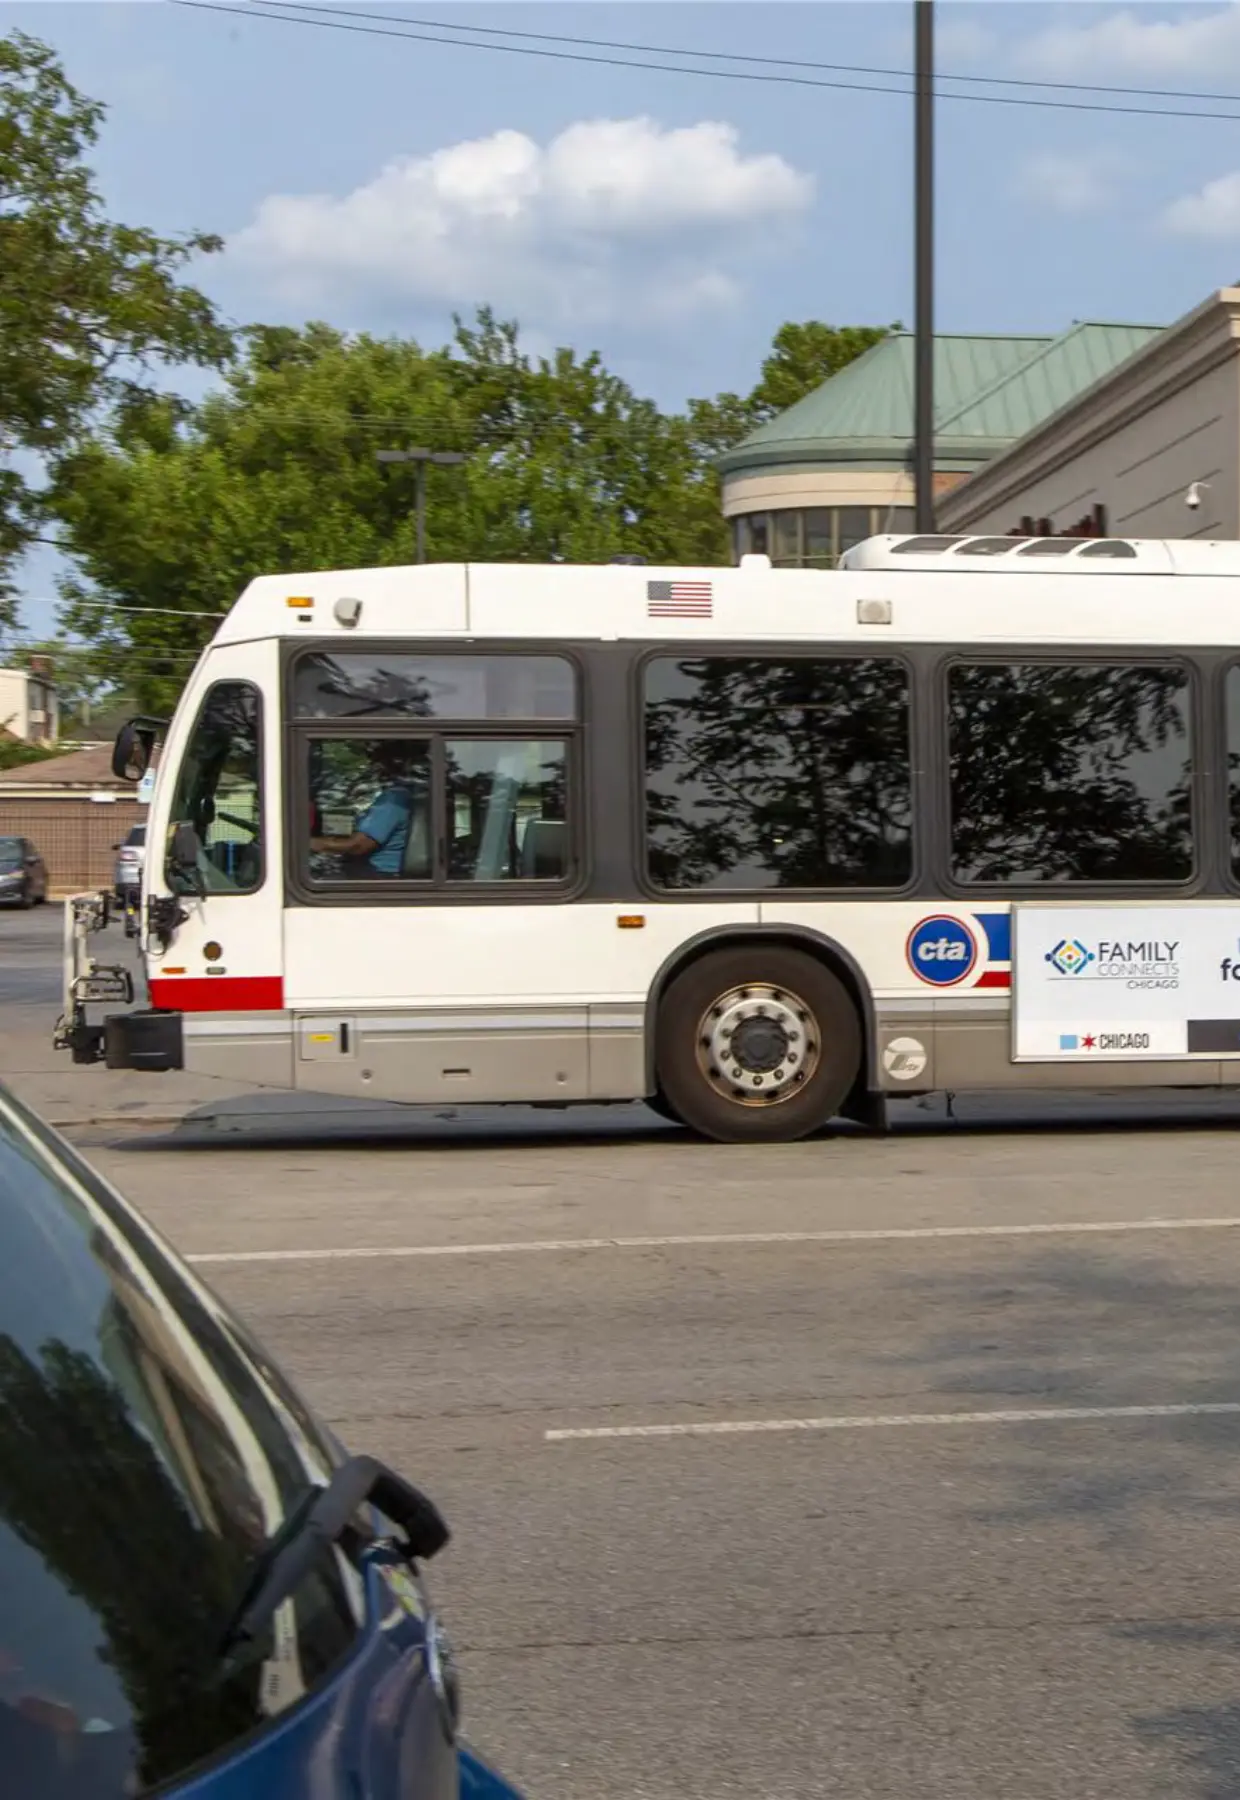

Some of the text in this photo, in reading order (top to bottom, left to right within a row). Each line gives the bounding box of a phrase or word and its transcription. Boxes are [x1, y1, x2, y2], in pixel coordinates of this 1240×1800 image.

[917, 938, 966, 961] cta
[1098, 941, 1179, 962] FAMILY
[1098, 962, 1179, 976] CONNECTS
[1126, 979, 1179, 989] CHICAGO
[1099, 1032, 1150, 1049] CHICAGO
